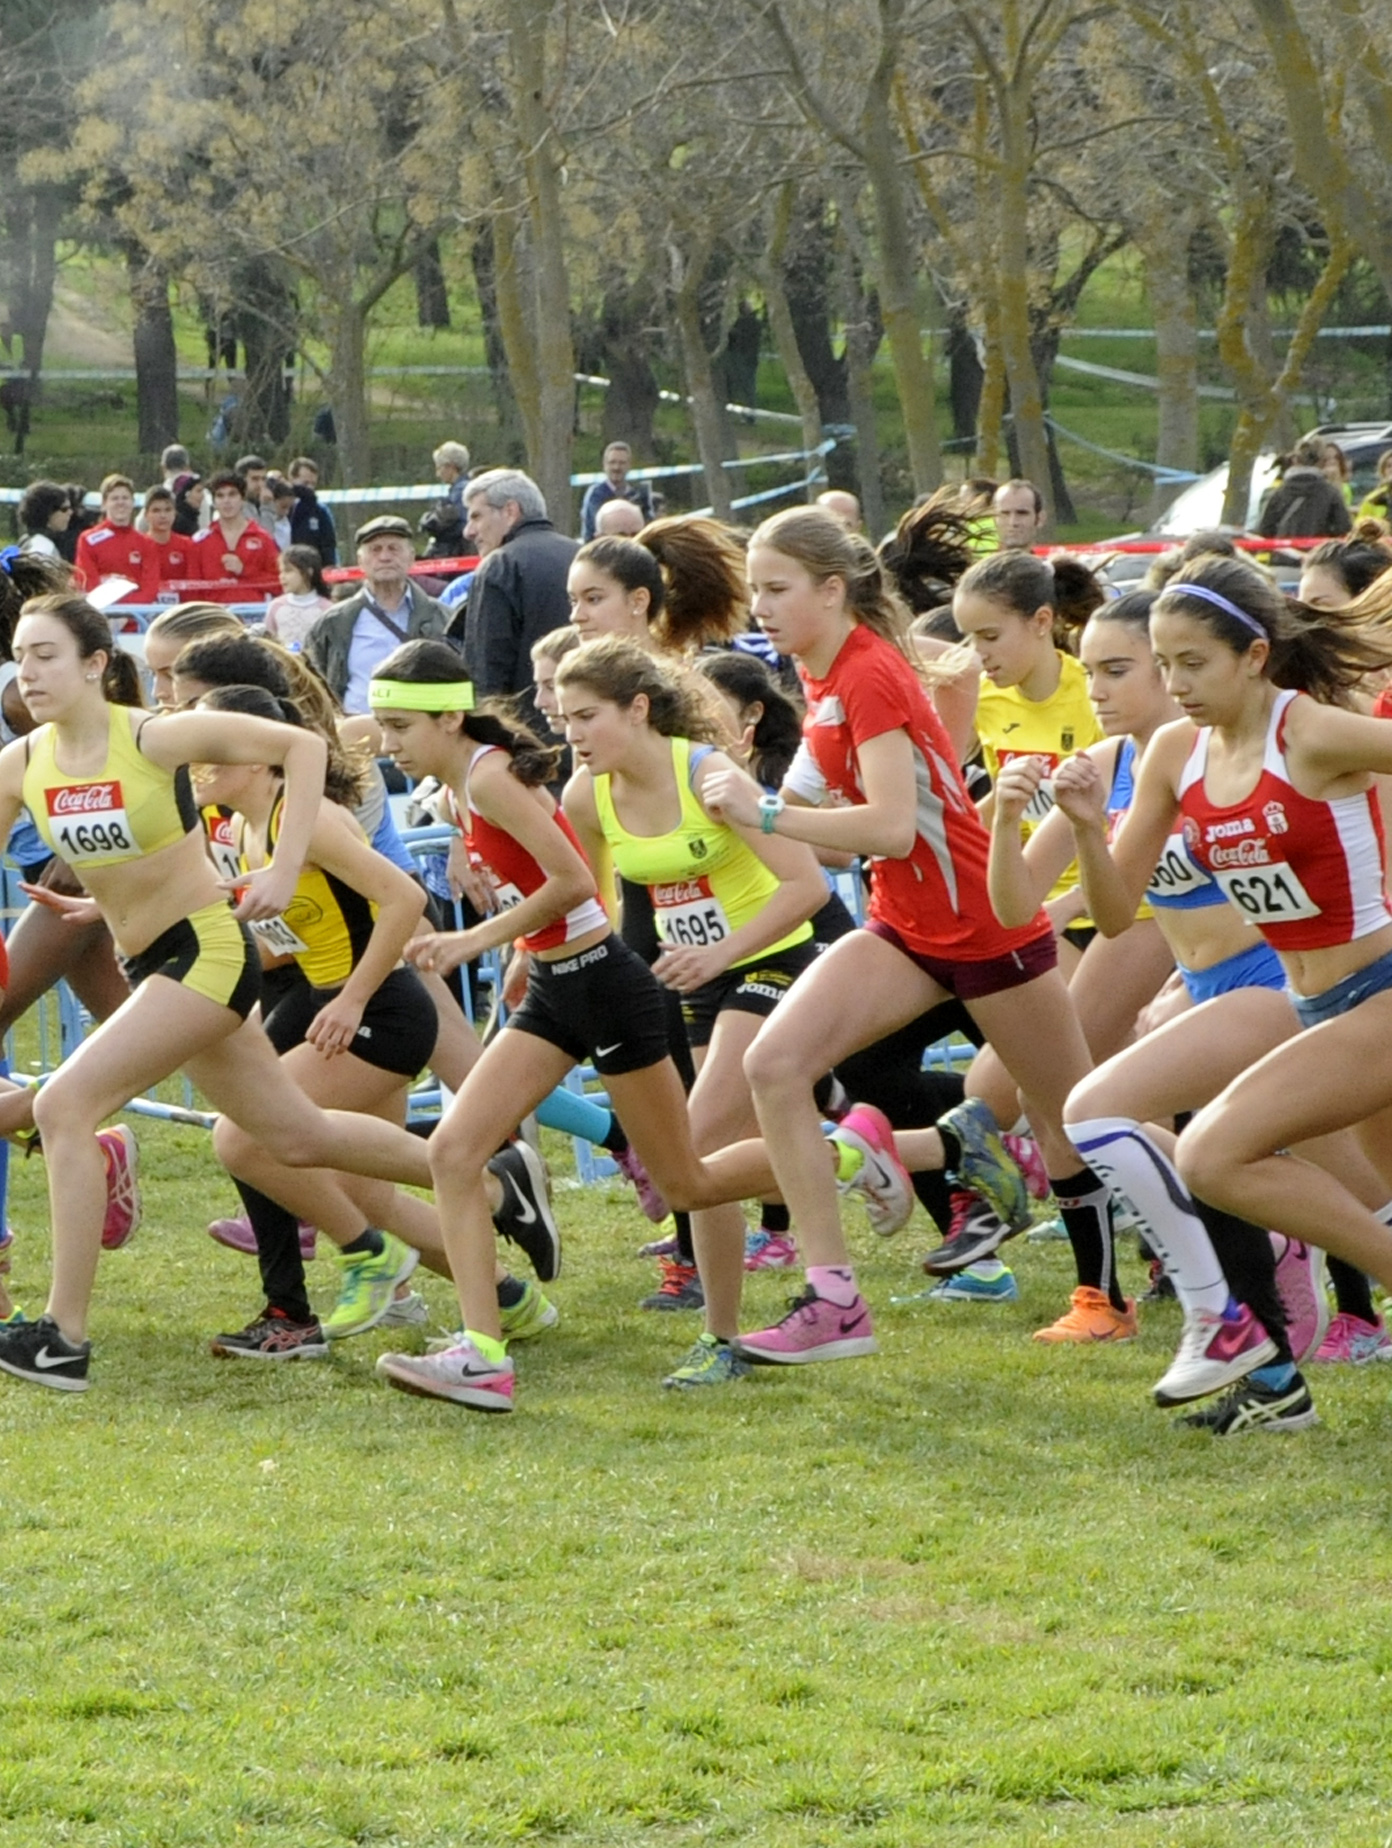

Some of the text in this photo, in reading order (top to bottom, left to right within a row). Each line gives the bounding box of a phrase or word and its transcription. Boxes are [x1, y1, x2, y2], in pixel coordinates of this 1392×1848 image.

[53, 785, 114, 814] Coca-Cola
[61, 822, 130, 855] 1698
[1209, 838, 1272, 869] Coca-Cola
[1229, 872, 1301, 914] 621
[666, 908, 725, 946] 1695
[551, 944, 608, 975] NIKE PRO
